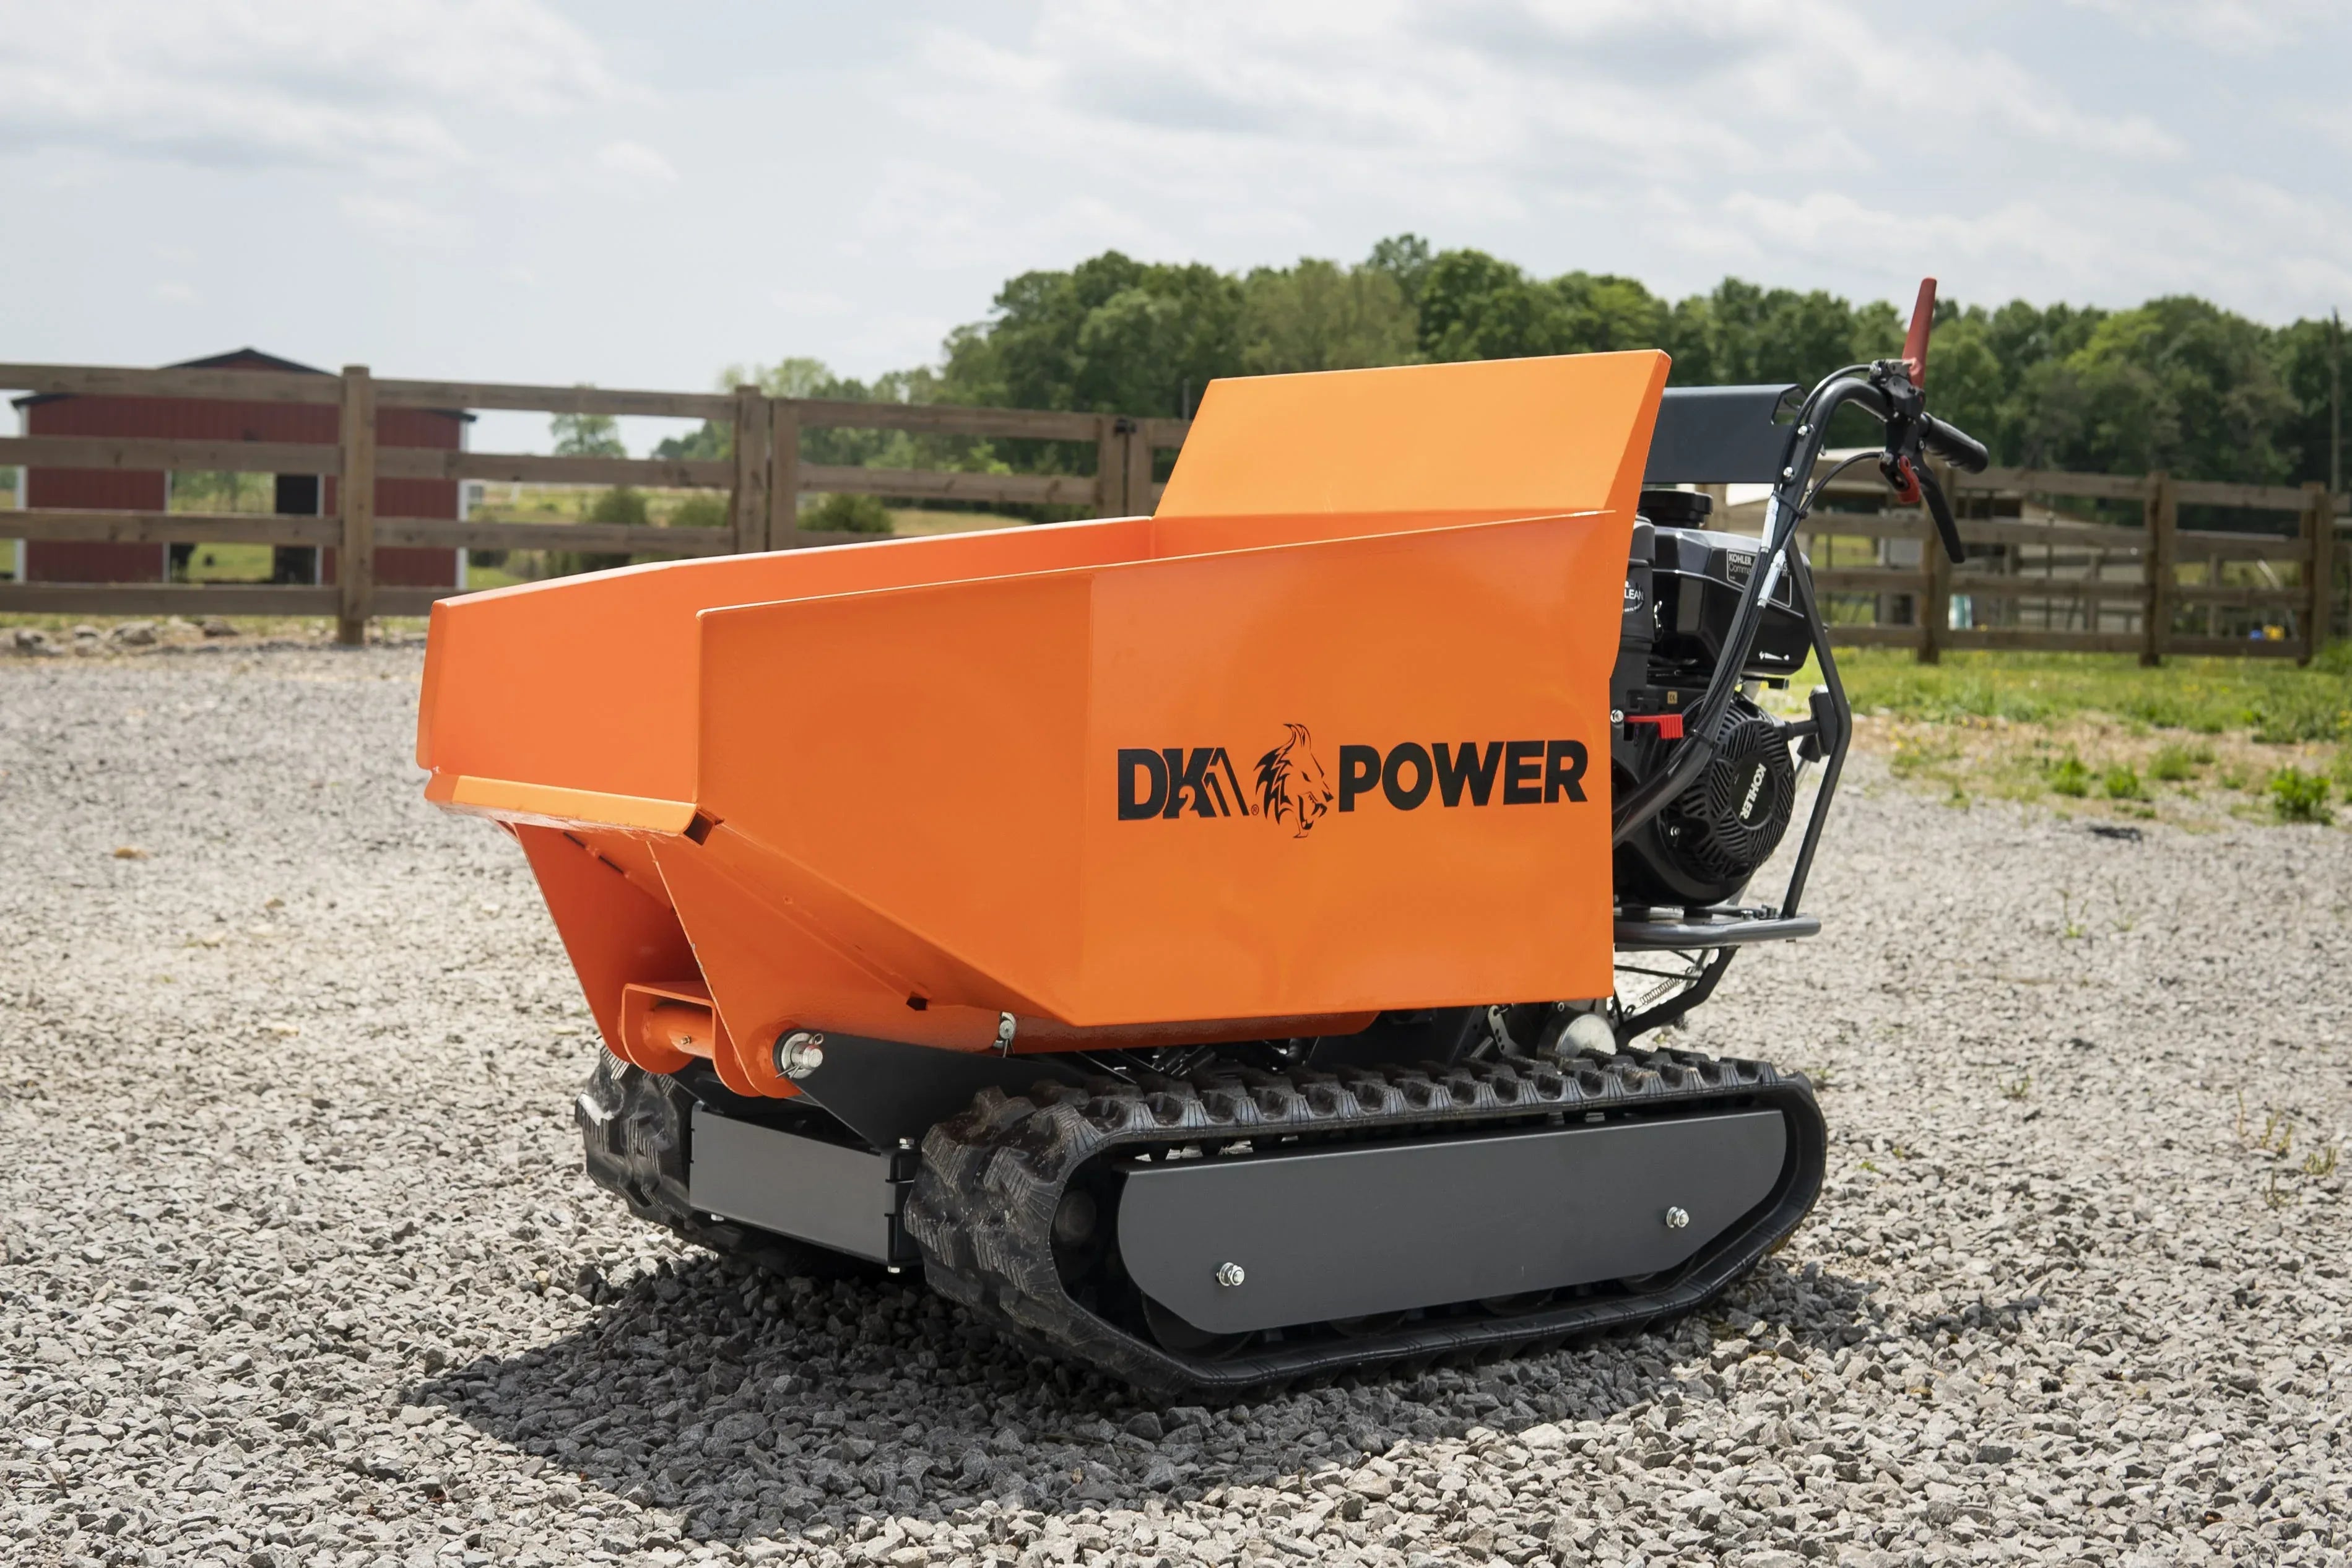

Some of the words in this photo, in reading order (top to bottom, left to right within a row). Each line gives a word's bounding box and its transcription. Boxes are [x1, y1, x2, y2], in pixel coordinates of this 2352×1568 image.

[1729, 553, 1751, 566] KOHLER
[1624, 588, 1644, 600] LEAN
[1339, 740, 1588, 812] POWER
[1738, 763, 1766, 820] KOHLER
